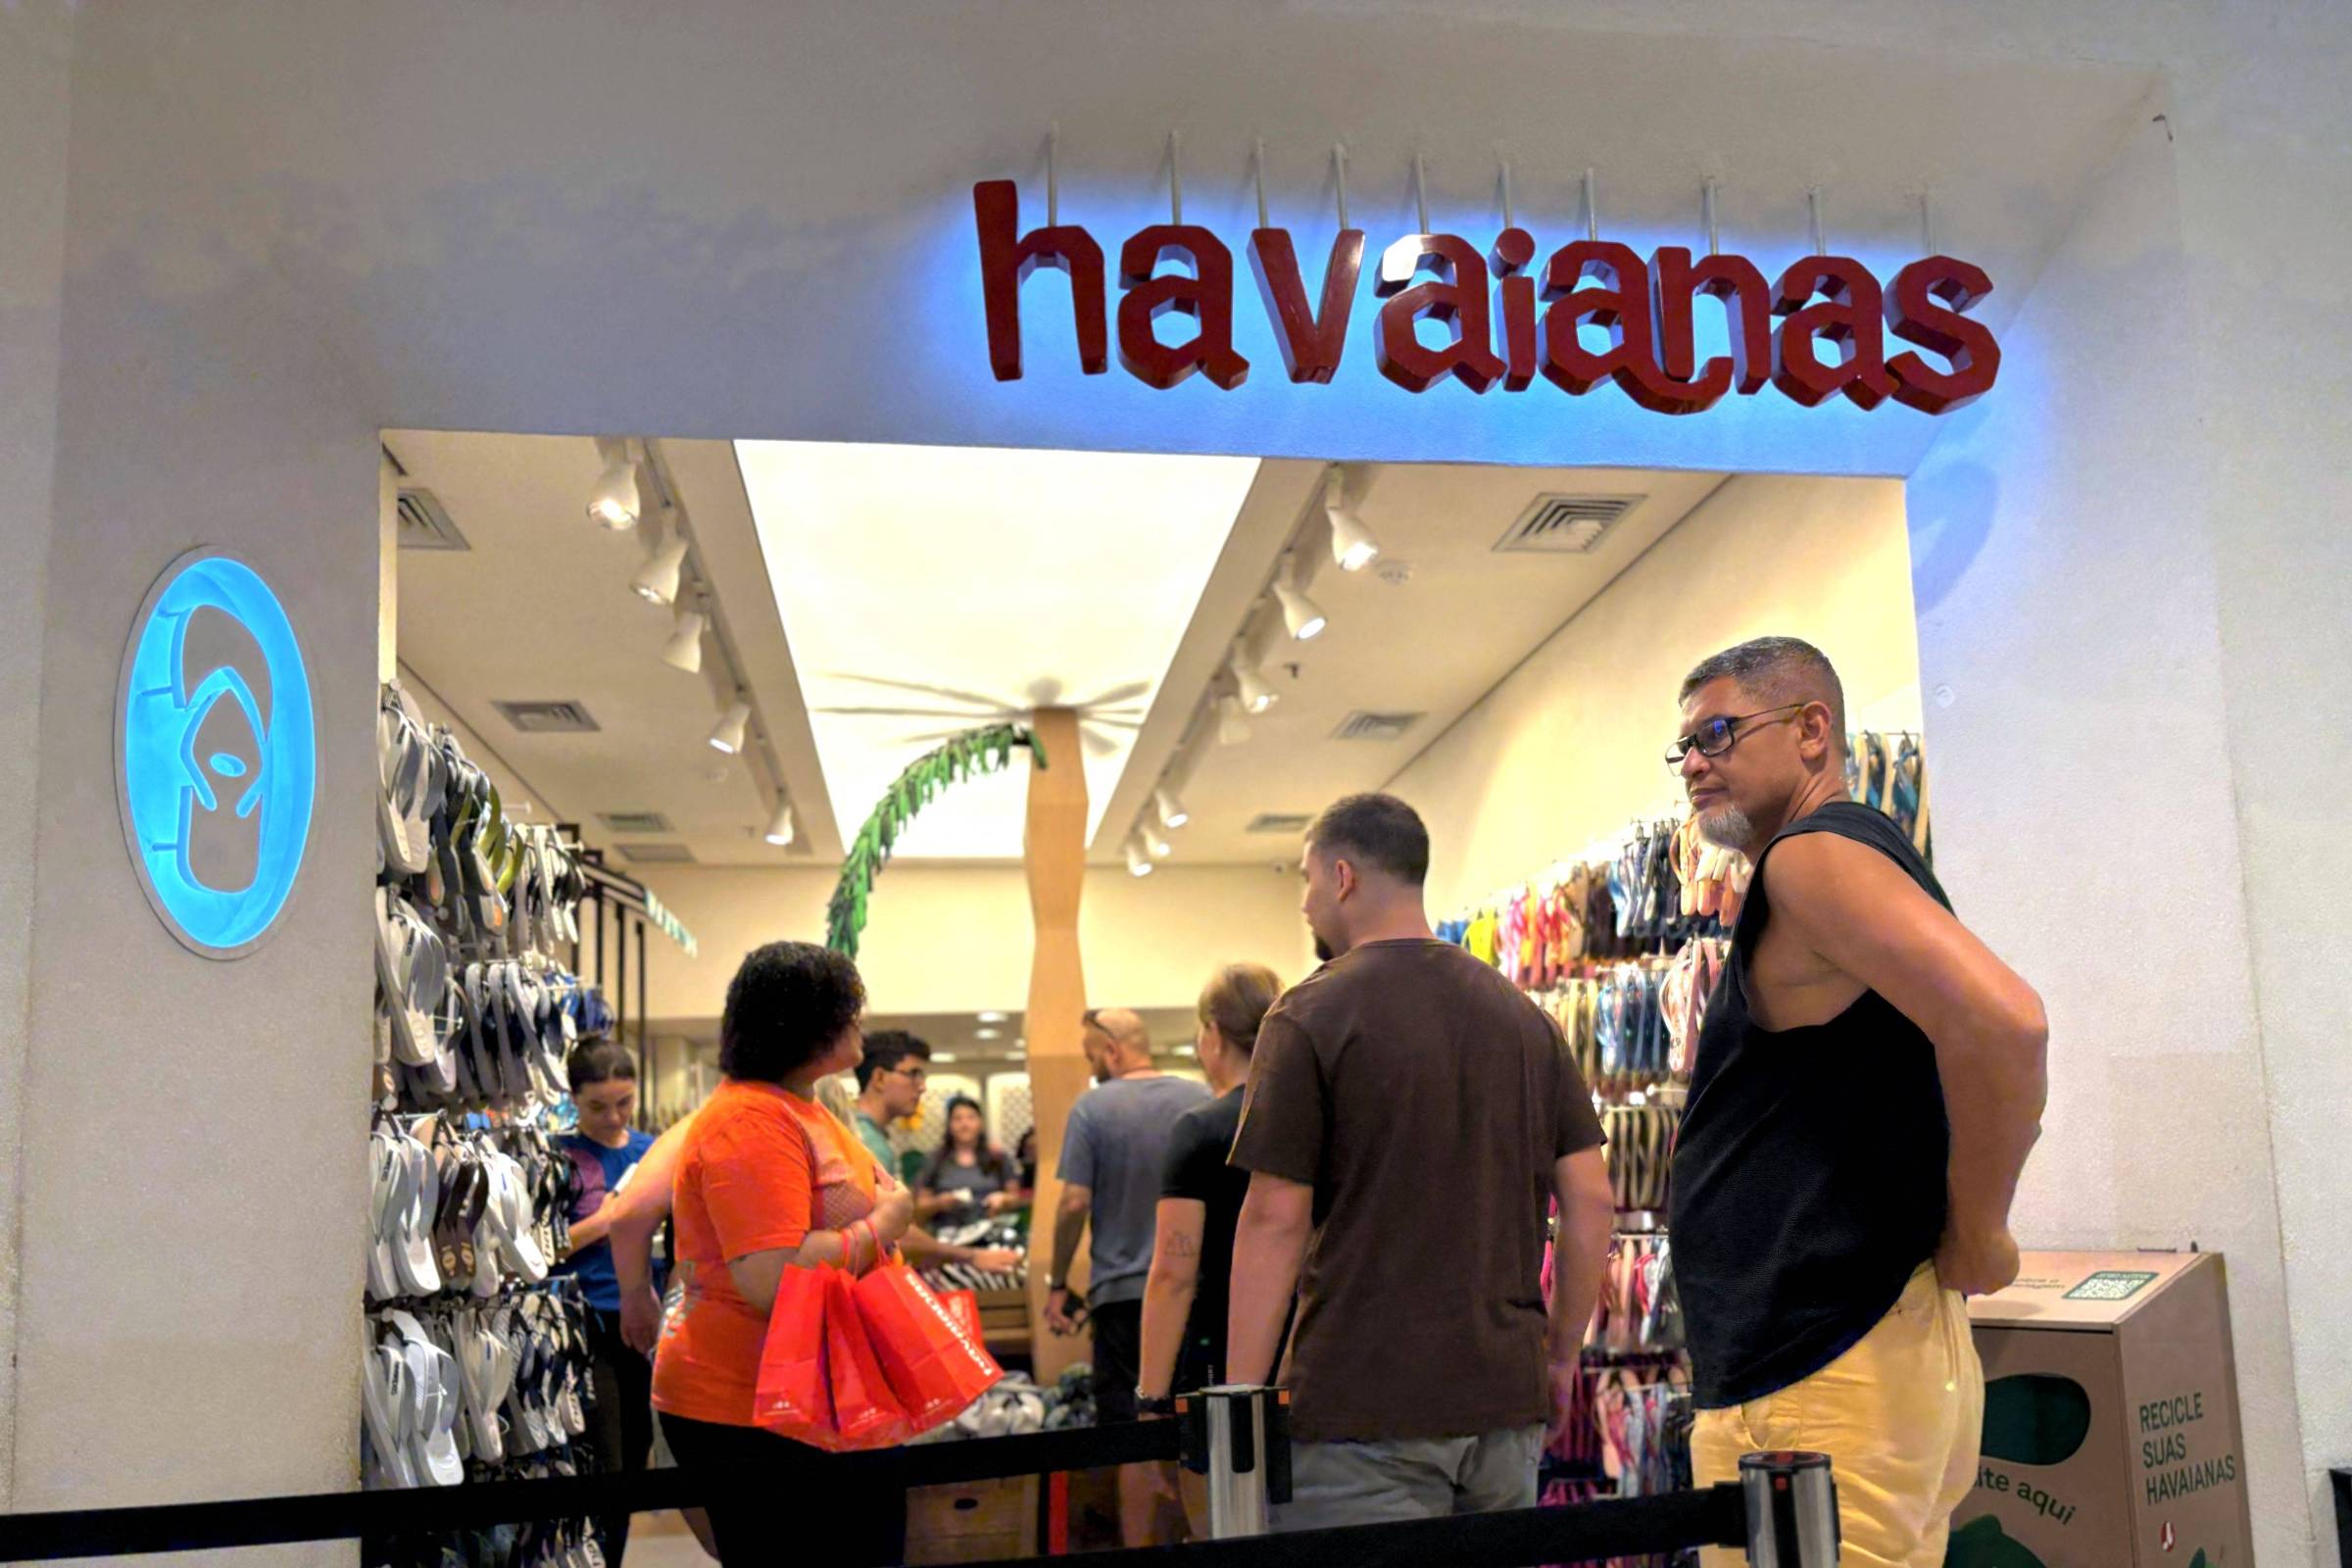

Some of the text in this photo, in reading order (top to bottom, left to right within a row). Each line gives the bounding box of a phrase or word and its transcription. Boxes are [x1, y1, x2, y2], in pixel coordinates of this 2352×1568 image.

[973, 180, 2002, 416] havaianas
[2139, 1393, 2203, 1433] RECICLE
[2142, 1433, 2186, 1468] SUAS
[2145, 1455, 2235, 1505] HAVAIANAS
[2017, 1481, 2077, 1525] aqui
